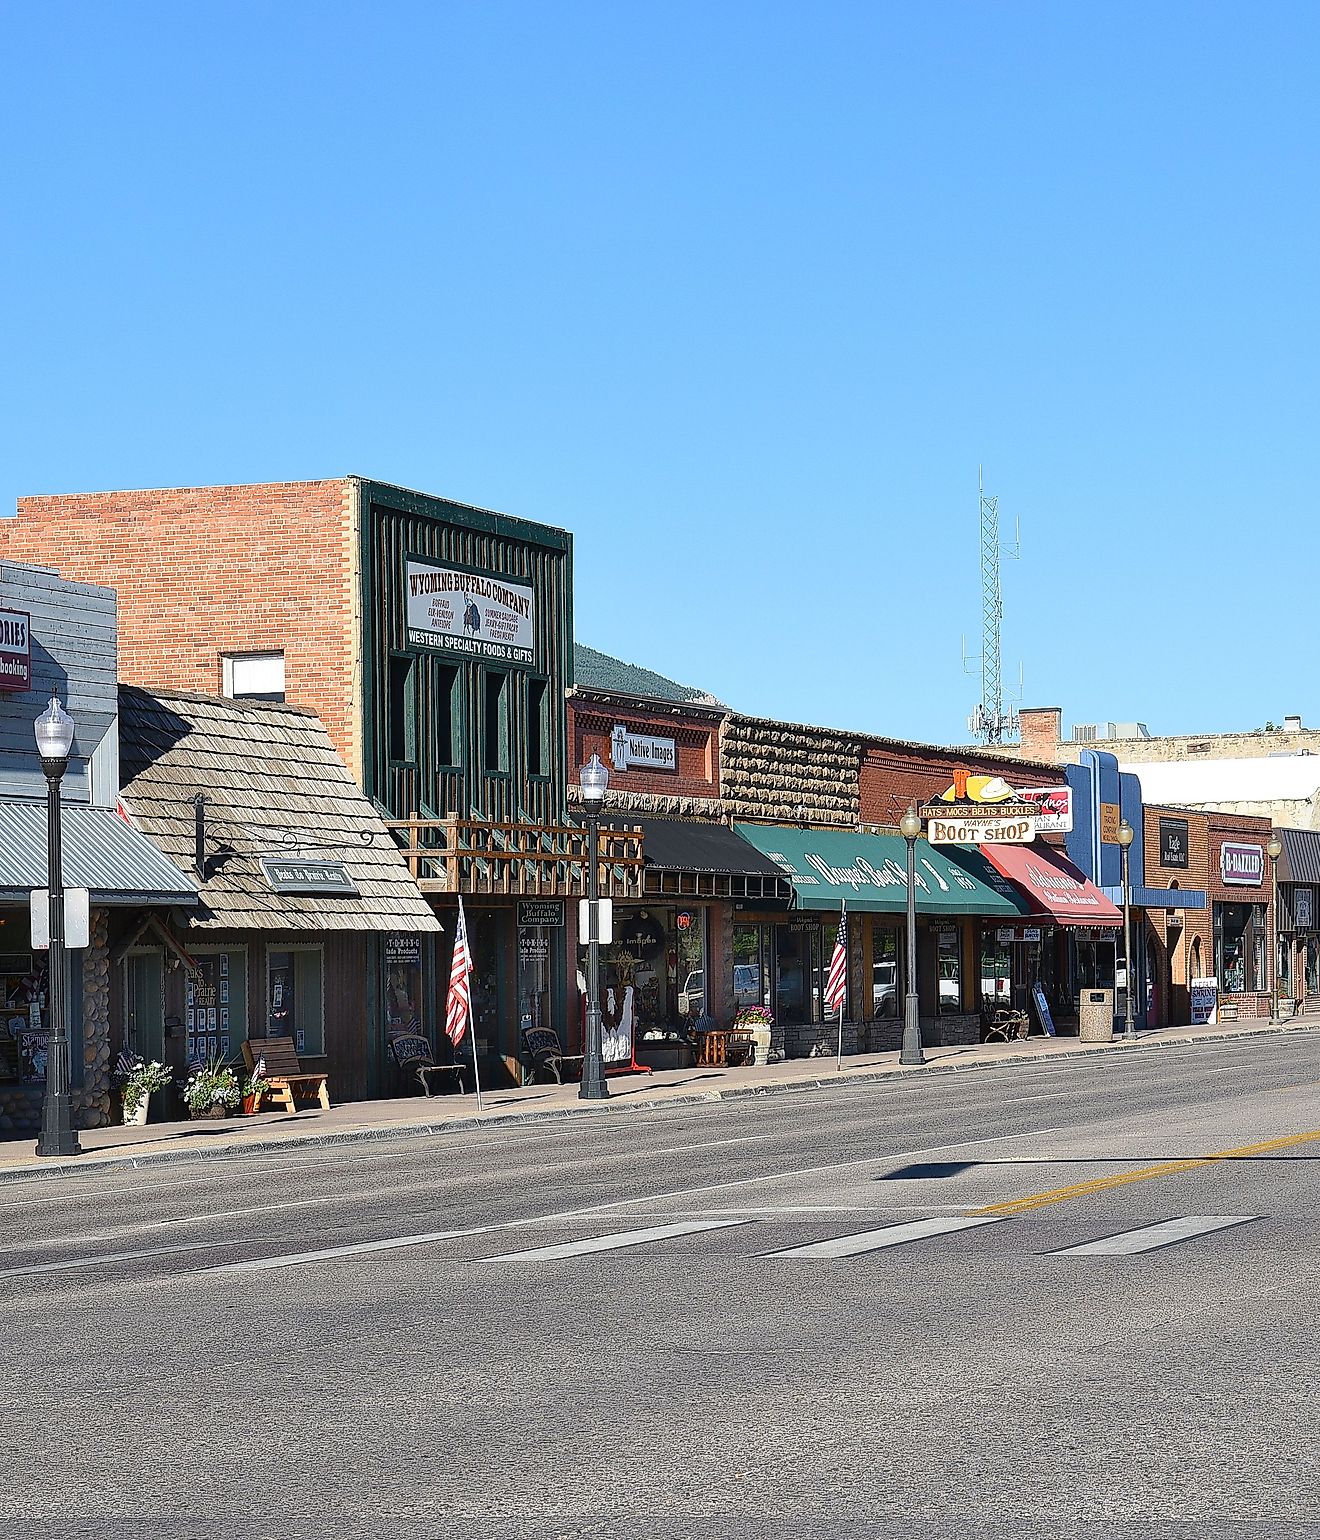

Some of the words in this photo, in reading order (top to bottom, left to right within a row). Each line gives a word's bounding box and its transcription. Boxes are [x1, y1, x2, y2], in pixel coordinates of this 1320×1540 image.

[409, 573, 452, 597] WYOMING
[454, 573, 491, 599] BUFFALO
[492, 583, 530, 619] COMPANY
[409, 629, 443, 647] WESTERN
[444, 636, 481, 653] SPECIALTY
[483, 642, 506, 657] FOODS
[507, 649, 513, 658] &
[513, 649, 533, 662] GIFTS
[629, 738, 650, 759] Native
[651, 741, 674, 764] Images
[922, 807, 942, 817] HATS
[946, 807, 968, 816] MOCS
[972, 807, 998, 816] BELTS
[1000, 805, 1035, 816] BUCKLES
[963, 819, 1001, 827] WAYNE'S
[933, 821, 980, 841] BOOT
[984, 821, 1030, 841] SHOP
[522, 902, 560, 911] Wyoming
[526, 909, 556, 917] Buffalo
[521, 915, 560, 925] Company
